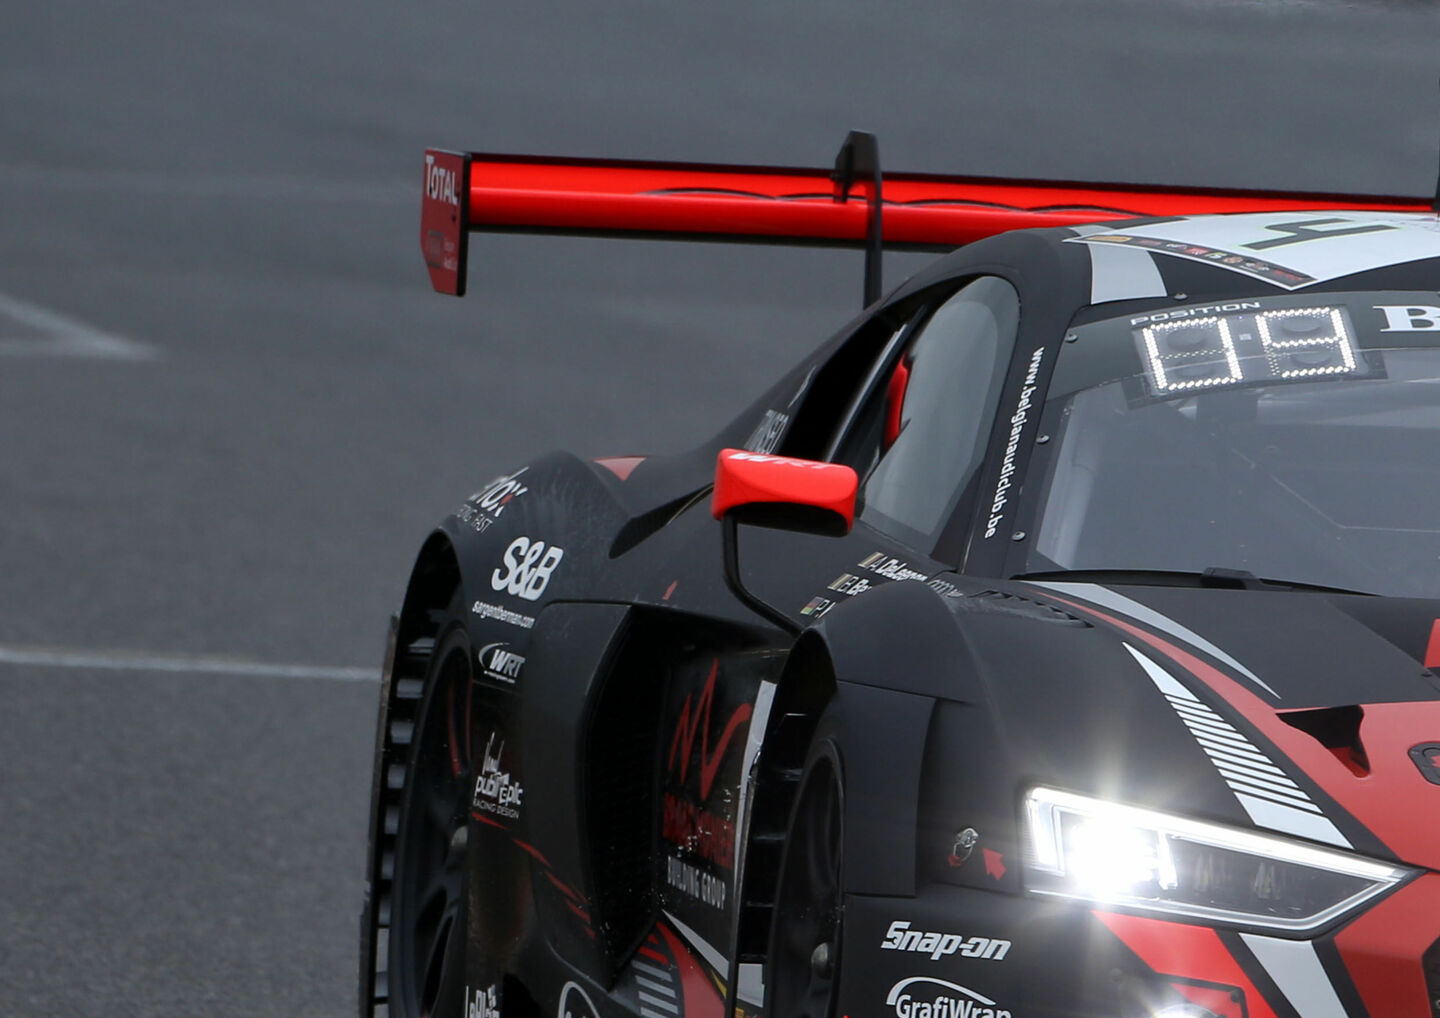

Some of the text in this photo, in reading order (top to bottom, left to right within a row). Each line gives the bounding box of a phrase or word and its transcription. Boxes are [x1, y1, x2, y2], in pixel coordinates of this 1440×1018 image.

[425, 155, 459, 206] TOTAL
[1130, 302, 1261, 327] POSITION
[985, 346, 1045, 539] www.belgianaudiclub.be
[491, 536, 564, 601] S&B
[489, 648, 526, 678] WRT
[880, 920, 1012, 961] Snap-on
